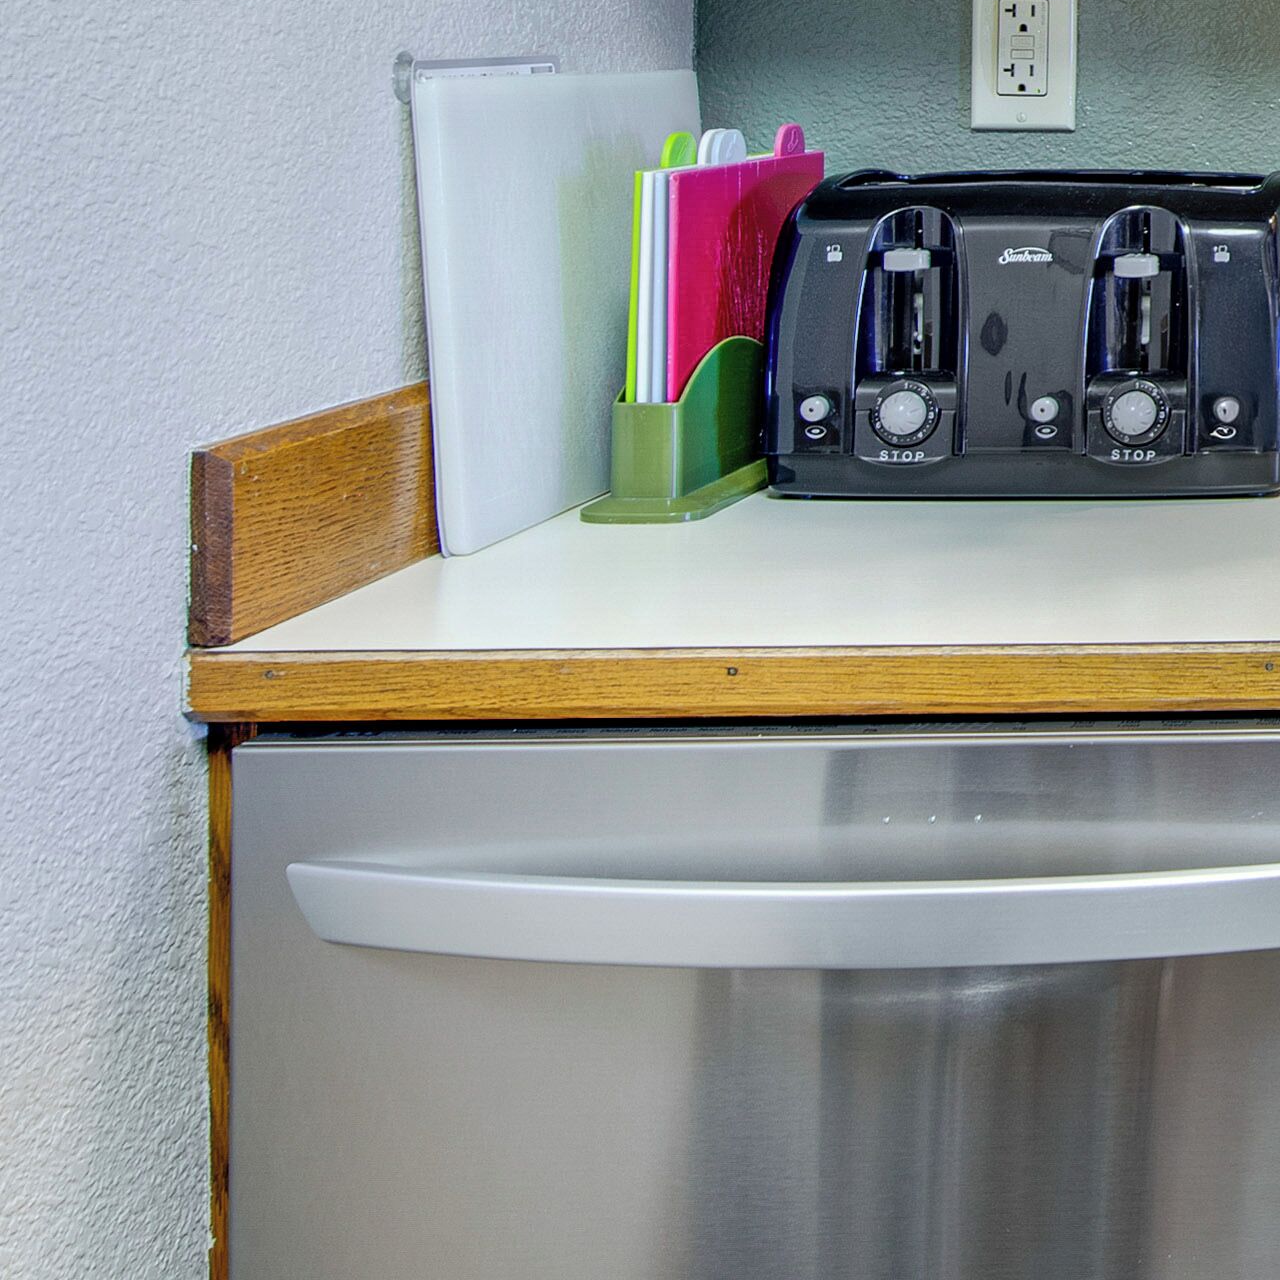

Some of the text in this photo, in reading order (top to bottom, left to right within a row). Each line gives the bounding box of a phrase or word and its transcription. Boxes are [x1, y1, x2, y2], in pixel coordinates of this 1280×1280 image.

[998, 246, 1053, 264] Sunbeam
[880, 450, 925, 462] STOP
[1111, 449, 1156, 461] STOP
